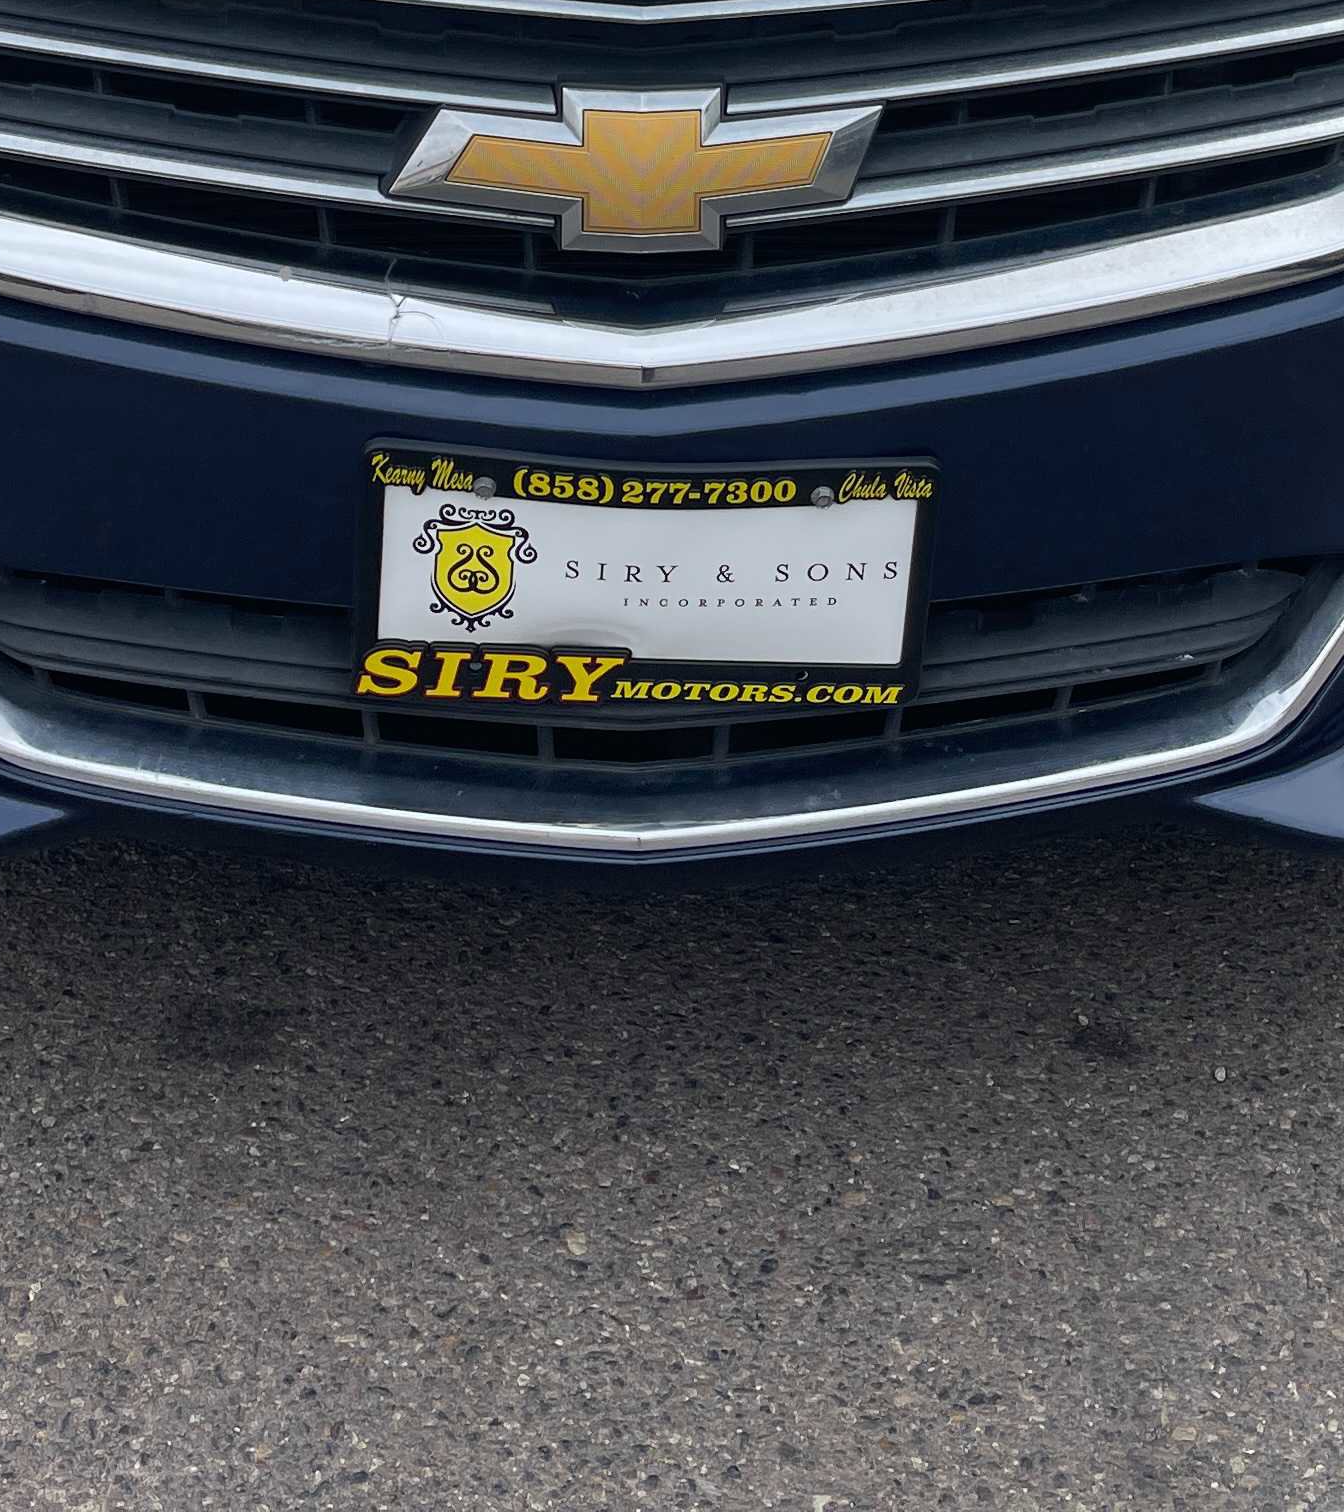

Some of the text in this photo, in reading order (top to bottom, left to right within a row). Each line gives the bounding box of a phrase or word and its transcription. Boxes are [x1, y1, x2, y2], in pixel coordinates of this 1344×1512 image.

[370, 453, 473, 492] Kearny Mesa
[513, 468, 797, 505] (858) 277-7300
[838, 470, 934, 503] Chula Vista
[564, 559, 899, 584] SIRY & SONS
[622, 597, 838, 609] INCORPORATED
